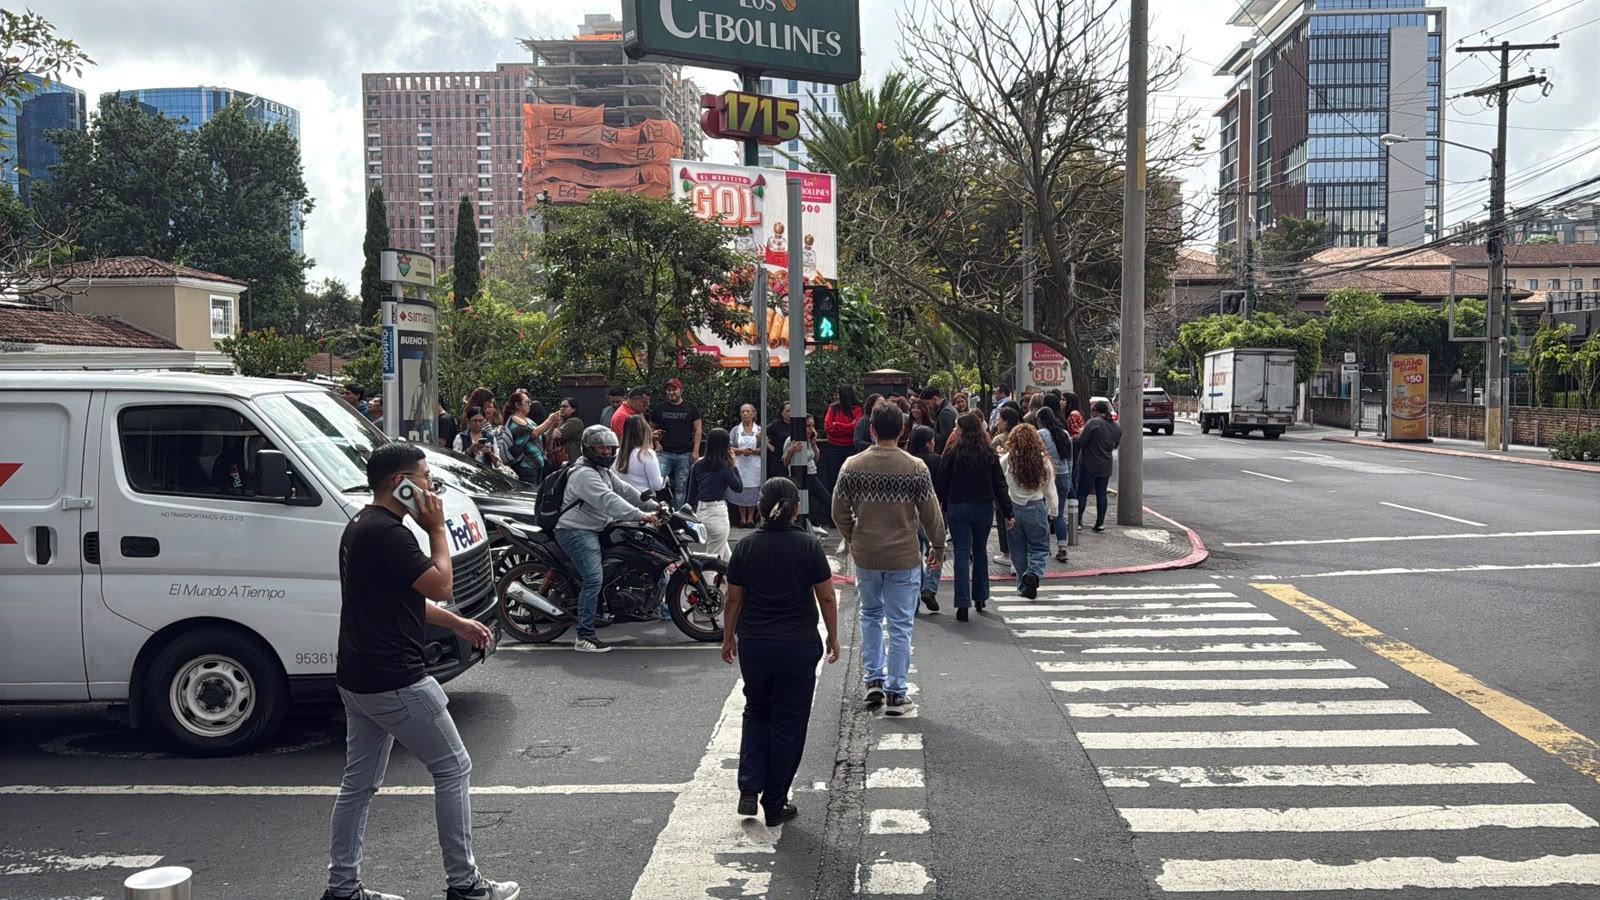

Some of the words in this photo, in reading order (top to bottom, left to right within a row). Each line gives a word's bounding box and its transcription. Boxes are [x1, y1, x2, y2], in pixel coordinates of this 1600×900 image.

[659, 0, 841, 57] CEBOLLINES
[553, 107, 574, 122] E4
[724, 92, 799, 139] 1715
[547, 128, 565, 141] E4
[636, 147, 657, 161] E4
[559, 185, 578, 198] E4
[692, 183, 763, 227] GOL
[1032, 366, 1066, 383] GOL
[445, 512, 483, 552] FedEx
[169, 583, 181, 596] El
[183, 583, 227, 597] Mundo
[228, 585, 239, 597] A
[241, 585, 286, 600] Tiempo
